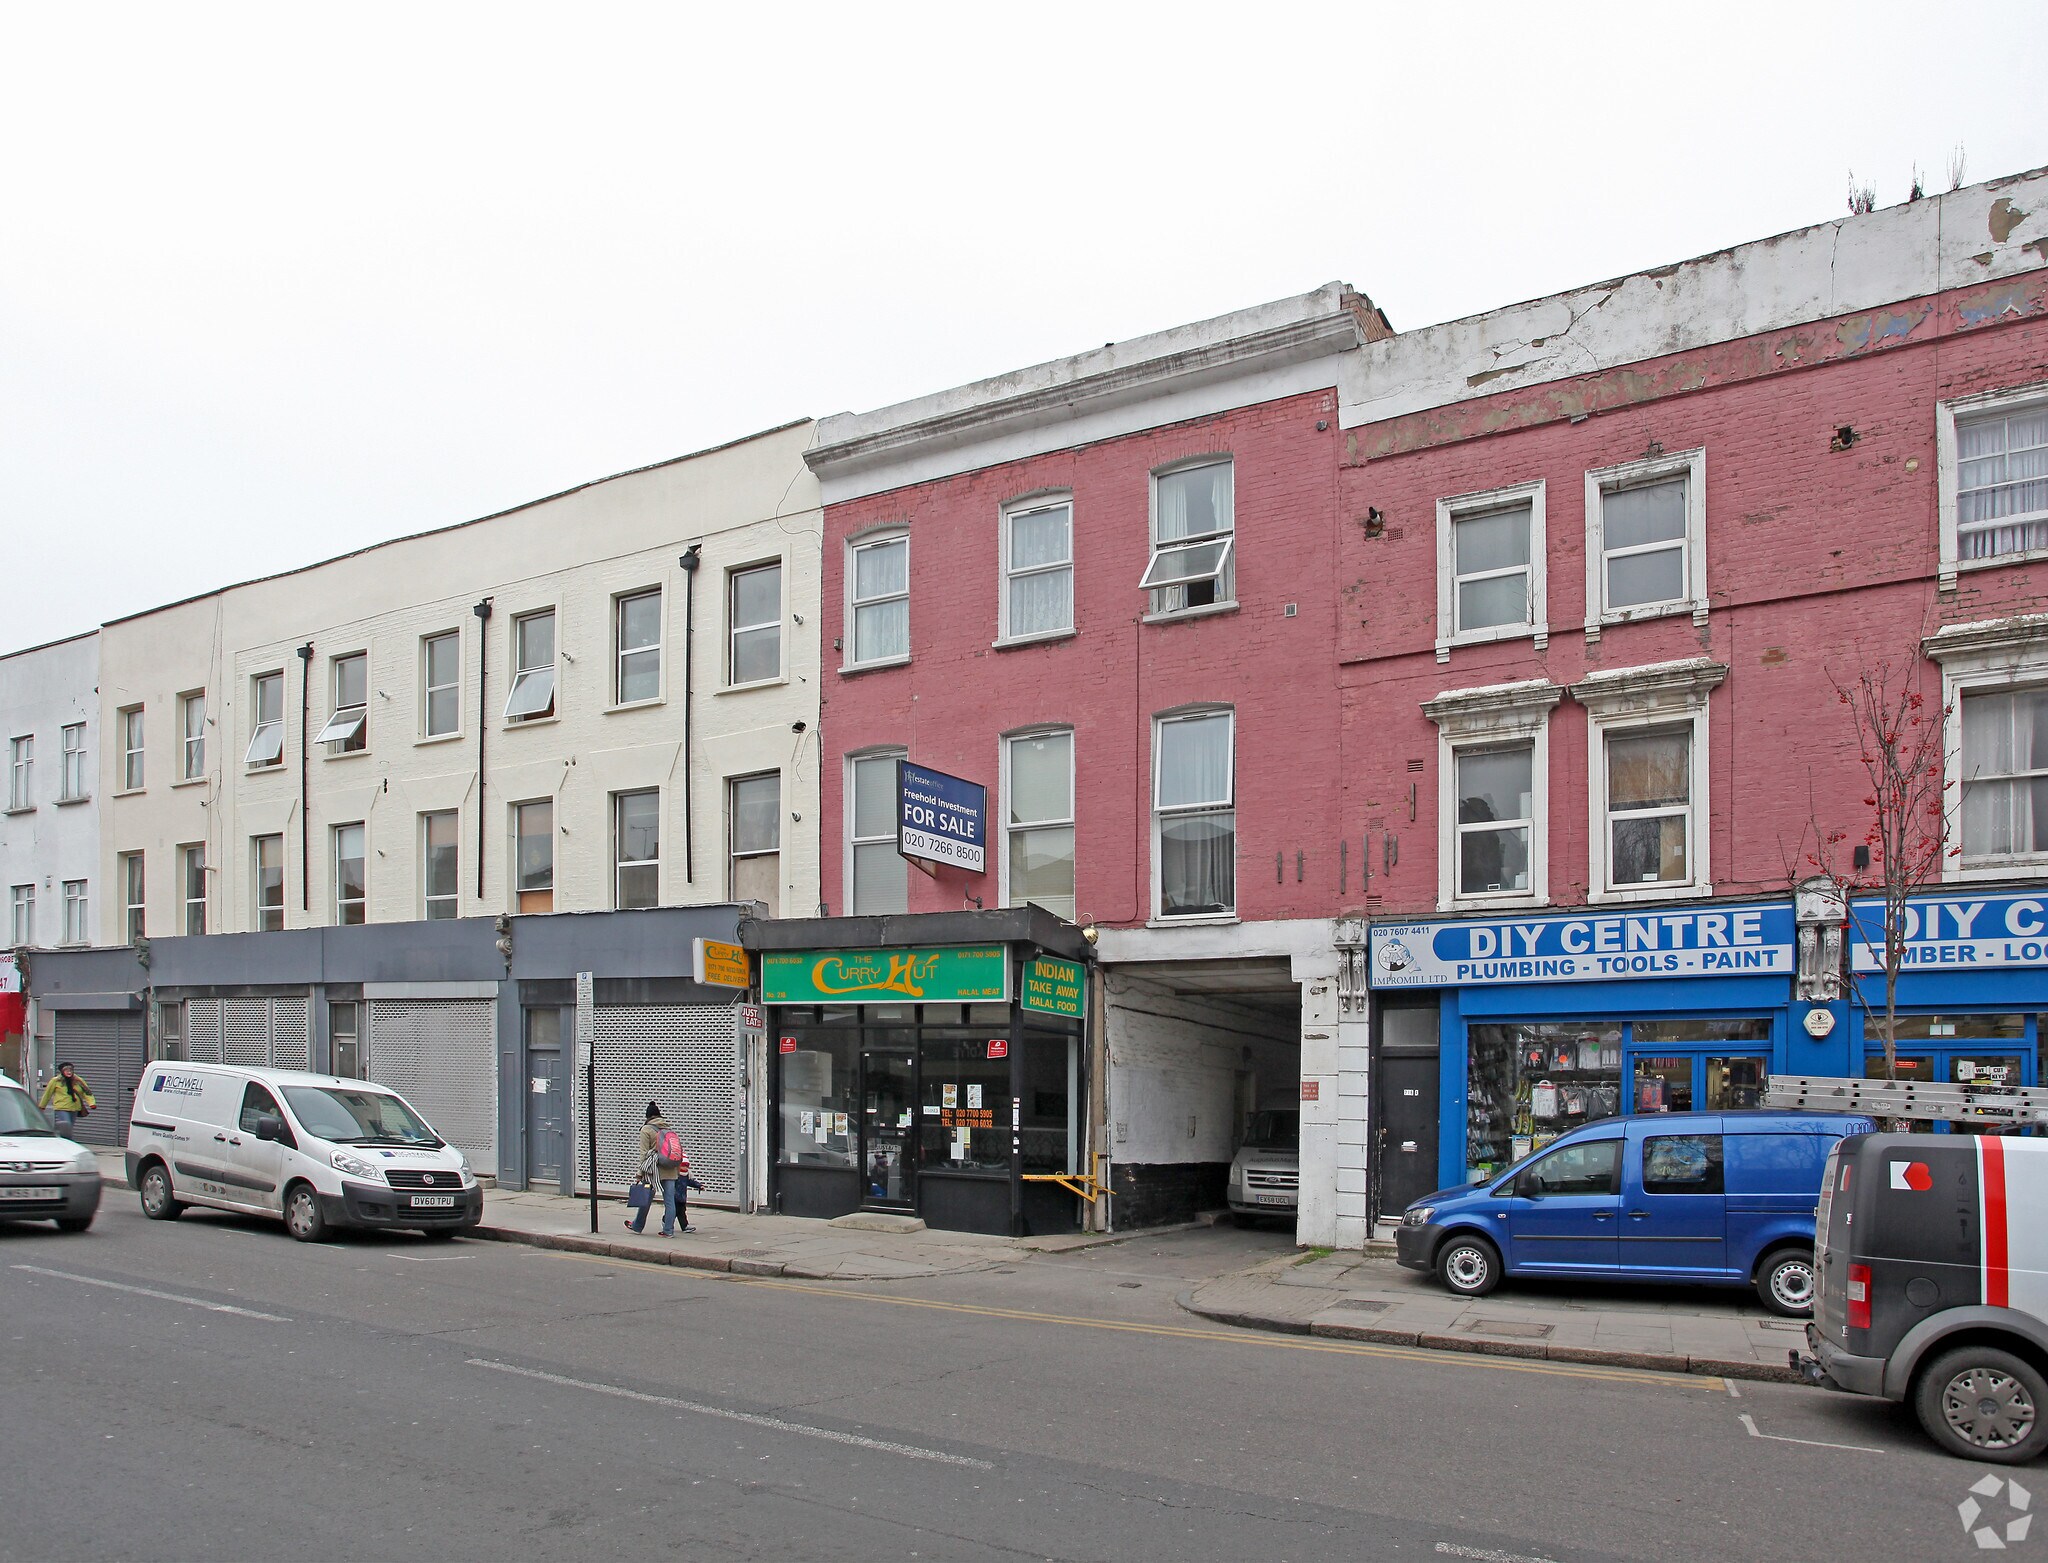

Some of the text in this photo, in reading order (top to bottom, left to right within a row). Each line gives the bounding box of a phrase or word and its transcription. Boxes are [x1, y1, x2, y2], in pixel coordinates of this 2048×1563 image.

[904, 788, 978, 817] Freehold Investment
[904, 803, 975, 839] FOR SALE
[904, 832, 925, 848] 020
[928, 838, 953, 855] 7266
[956, 845, 981, 862] 8500
[1884, 902, 1986, 941] DIY
[1373, 926, 1430, 937] 020 7607 4411
[1469, 911, 1763, 959] DIY CENTRE
[854, 955, 873, 963] THE
[1868, 944, 1977, 964] TMBER
[2004, 942, 2048, 961] LO
[1035, 961, 1075, 983] INDIAN
[1457, 959, 1576, 980] PLUMBING
[1596, 954, 1679, 974] TOOLS
[1702, 949, 1779, 969] PAINT
[708, 972, 748, 984] FREE DELIVERY
[812, 954, 940, 997] CURRY HUT
[1373, 975, 1448, 985] IMPROMILL LTD
[957, 988, 980, 996] HALAL
[1028, 979, 1079, 999] TAKE AWAY
[1029, 996, 1077, 1012] HALAL FOOD
[741, 1007, 758, 1018] JUST
[745, 1016, 759, 1027] EAT
[165, 1075, 204, 1091] RICHWELL
[941, 1109, 993, 1119] TEL: 020 7700 5905
[941, 1118, 993, 1128] TEL: 020 7700 6032
[414, 1195, 452, 1205] DV60 TPU
